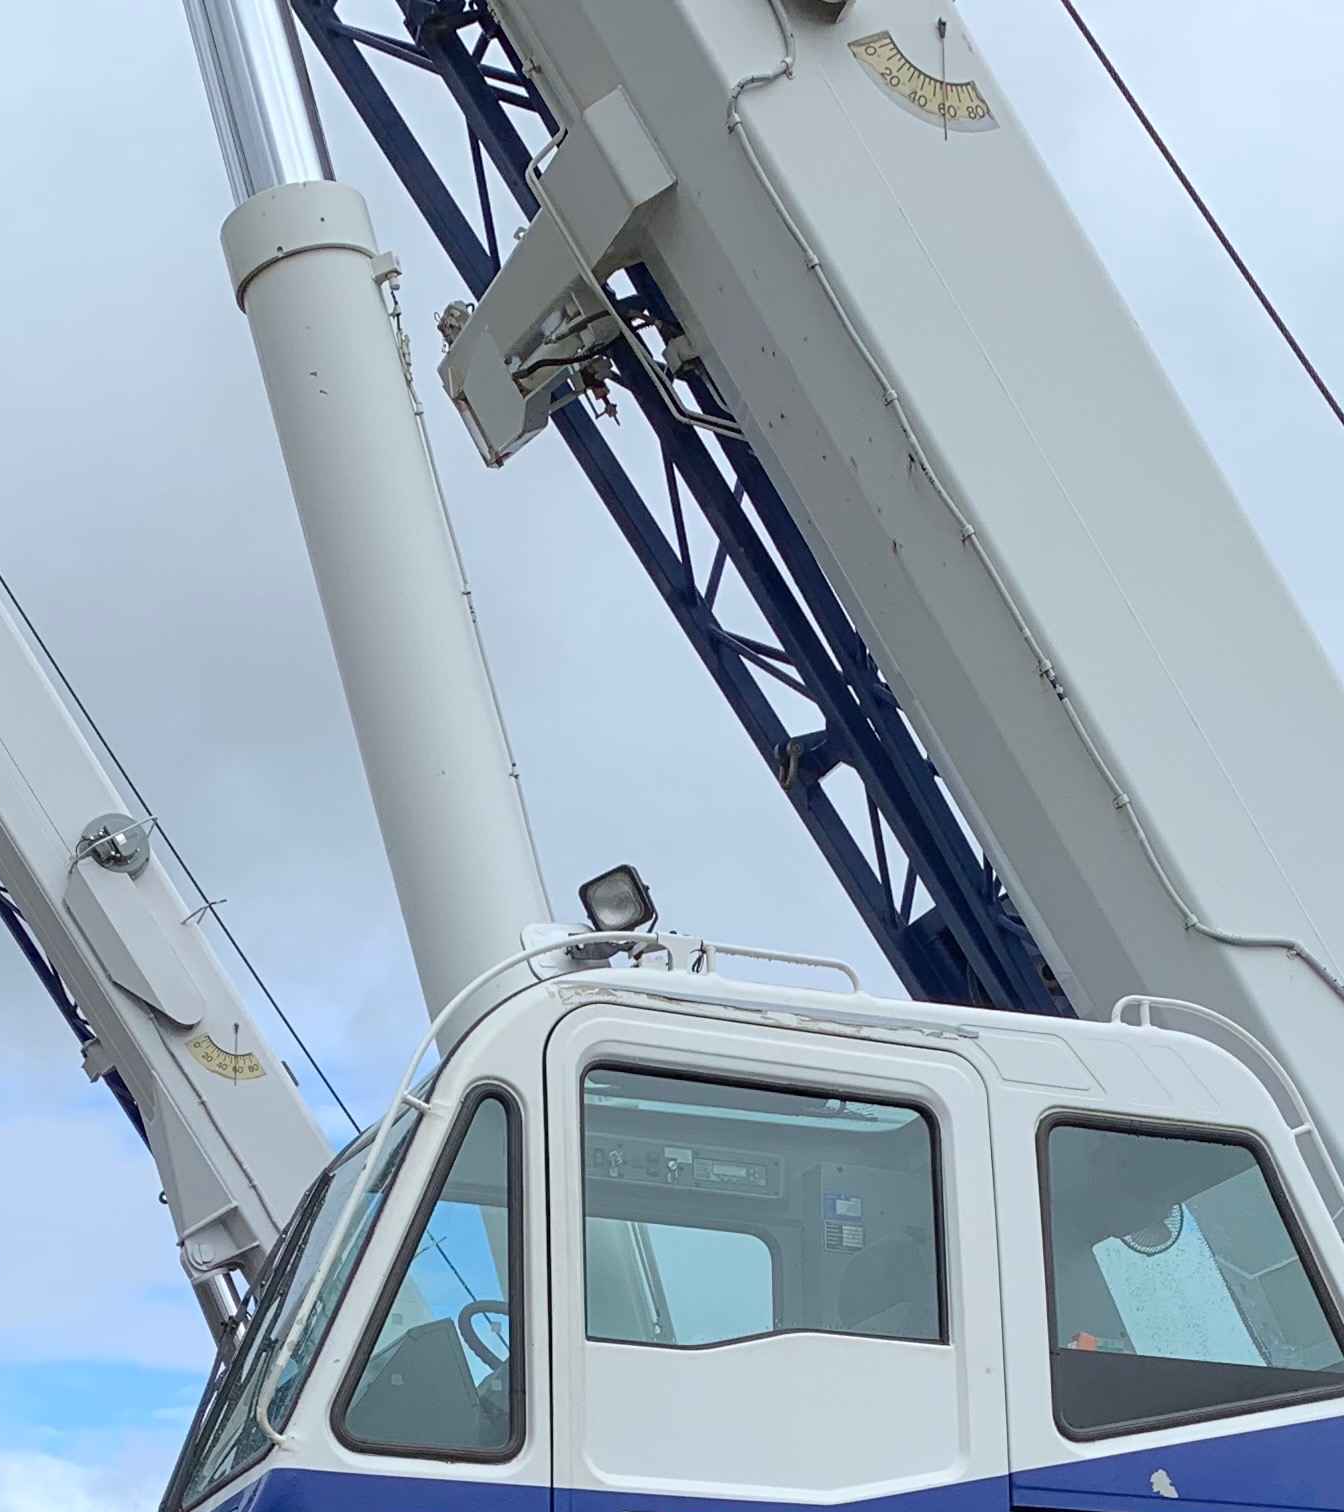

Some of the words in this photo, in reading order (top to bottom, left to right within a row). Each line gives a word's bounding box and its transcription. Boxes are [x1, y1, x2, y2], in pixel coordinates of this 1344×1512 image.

[864, 45, 877, 57] 0
[880, 66, 901, 88] 20
[908, 90, 928, 109] 40
[937, 102, 957, 119] 60
[966, 104, 986, 121] 80
